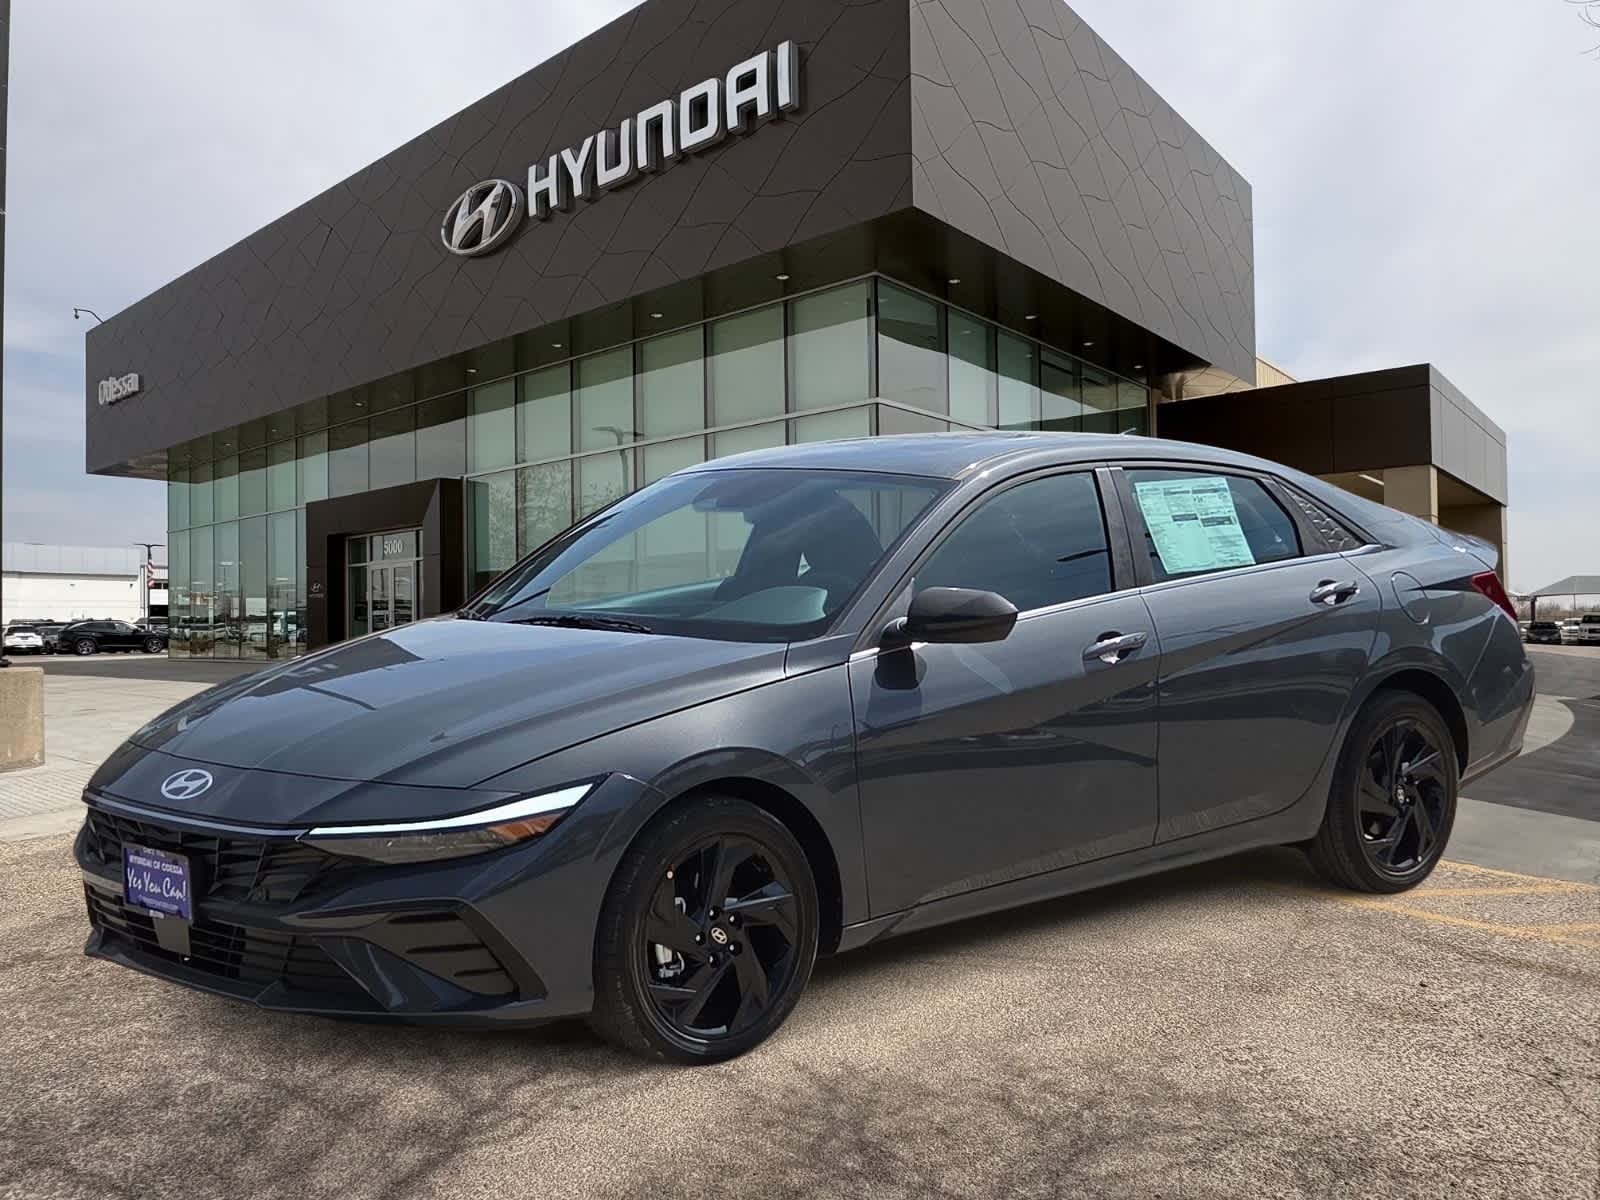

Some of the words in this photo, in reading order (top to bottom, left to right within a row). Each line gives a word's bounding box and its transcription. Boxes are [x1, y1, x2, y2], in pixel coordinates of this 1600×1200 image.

[527, 40, 801, 219] HYUNDAI
[98, 373, 140, 405] Odessa
[383, 540, 404, 555] 5000
[127, 867, 142, 890] Yes
[143, 871, 161, 892] You
[162, 877, 186, 902] Can!
